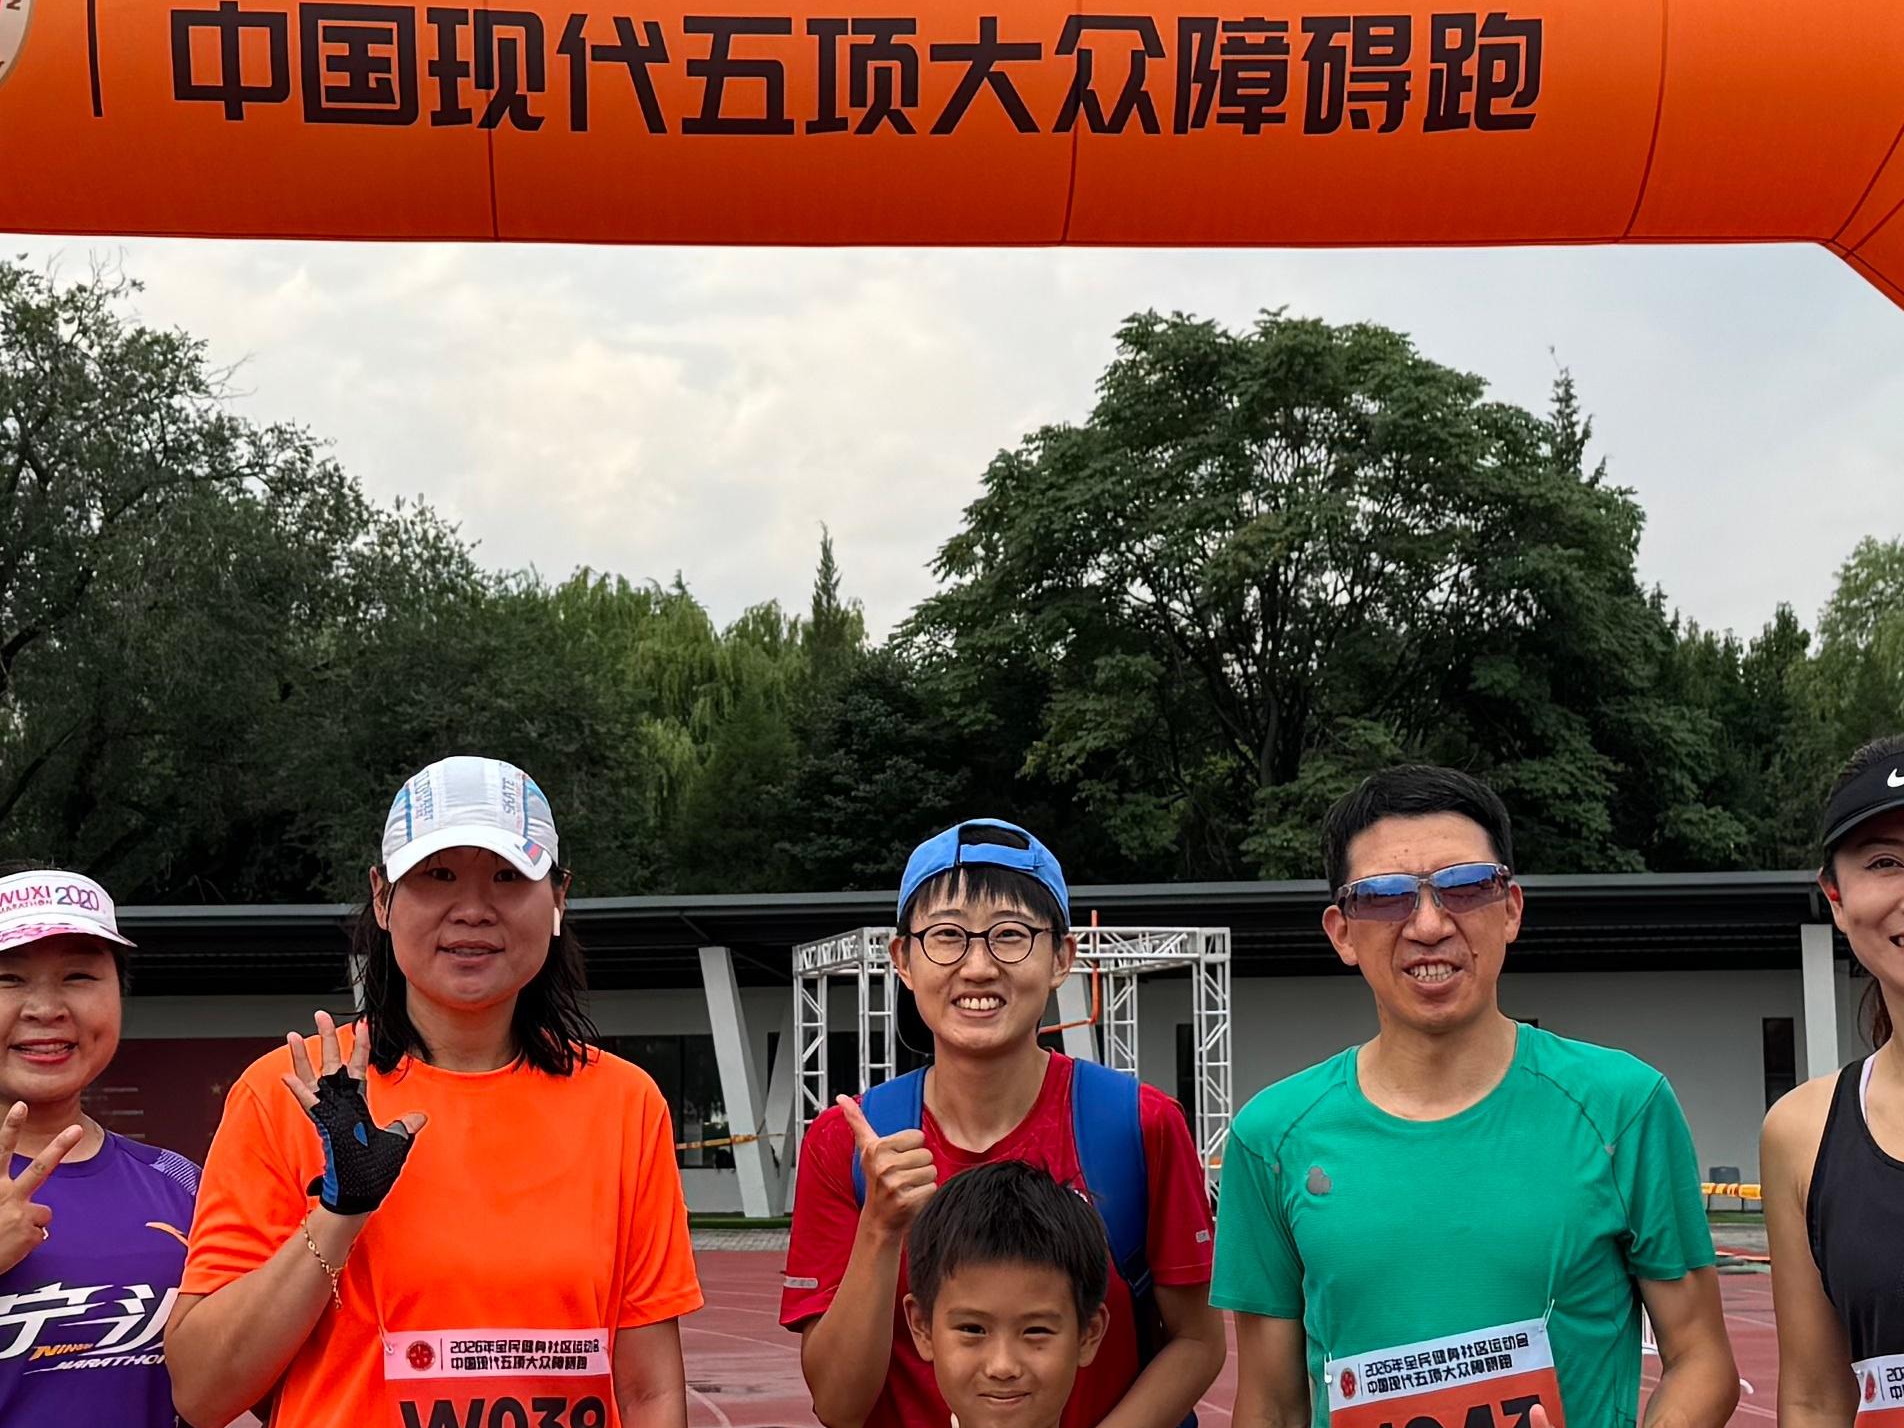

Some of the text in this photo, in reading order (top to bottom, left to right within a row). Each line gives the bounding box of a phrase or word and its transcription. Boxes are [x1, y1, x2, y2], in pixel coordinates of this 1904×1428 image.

[169, 0, 1543, 134] 中国现代五项大众障碍跑
[55, 885, 99, 911] 2020
